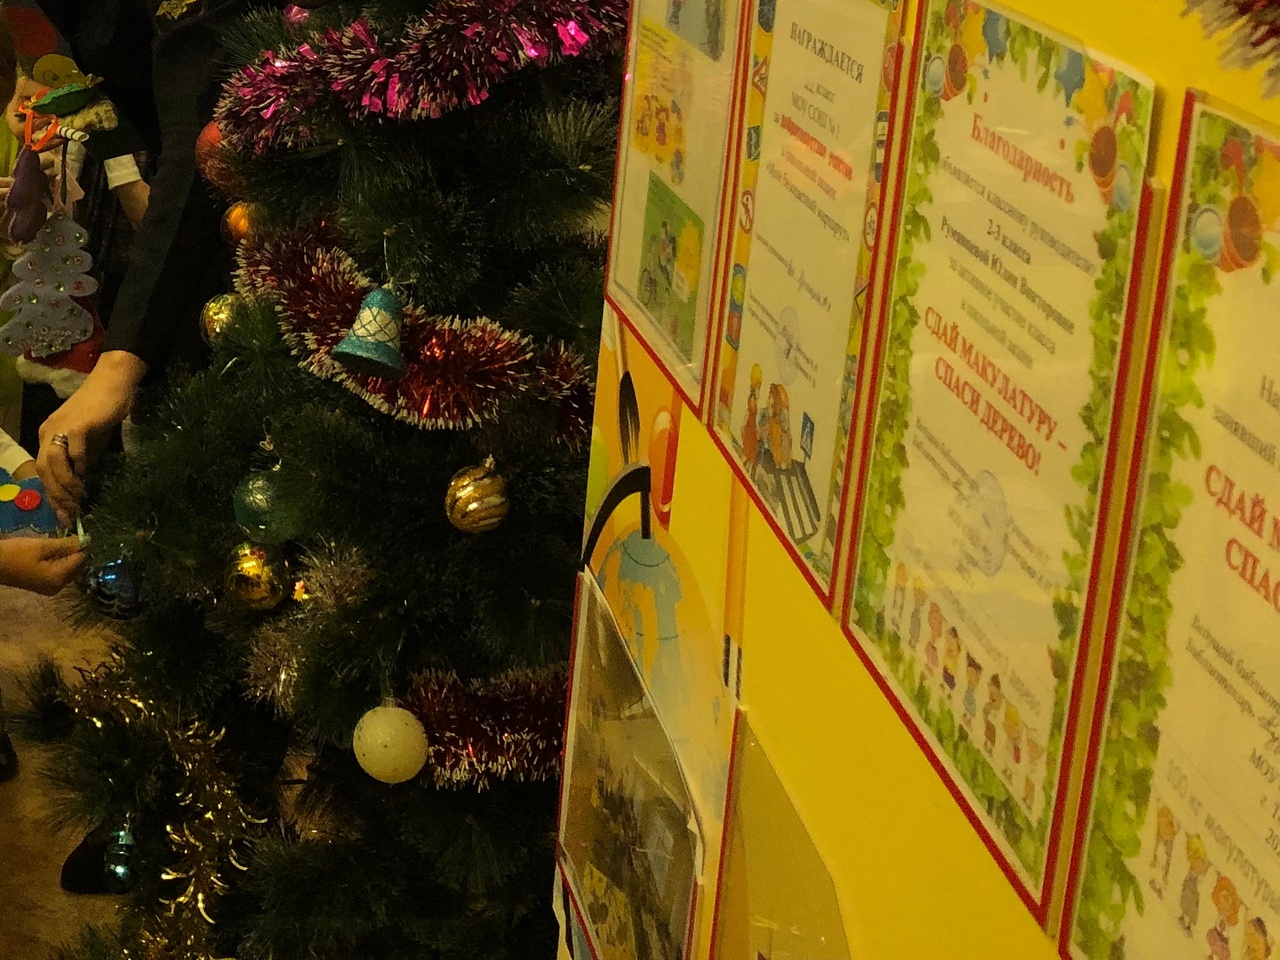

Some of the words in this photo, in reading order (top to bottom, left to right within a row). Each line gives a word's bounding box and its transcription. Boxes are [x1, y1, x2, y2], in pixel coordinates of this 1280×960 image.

[791, 21, 863, 83] НАГРАЖДАЕТСЯ
[808, 104, 826, 128] СОШ
[972, 113, 1075, 205] Благодарность
[942, 216, 989, 265] Румянцевой
[992, 255, 1017, 288] Юлии
[987, 218, 1000, 241] 2-3
[1002, 234, 1031, 264] класса
[925, 305, 959, 353] СДАЙ
[961, 337, 1057, 442] МАКУЛАТУРУ
[936, 354, 980, 415] СПАСИ
[981, 399, 1041, 476] ДЕРЕВО!
[1205, 464, 1267, 540] СДАЙ
